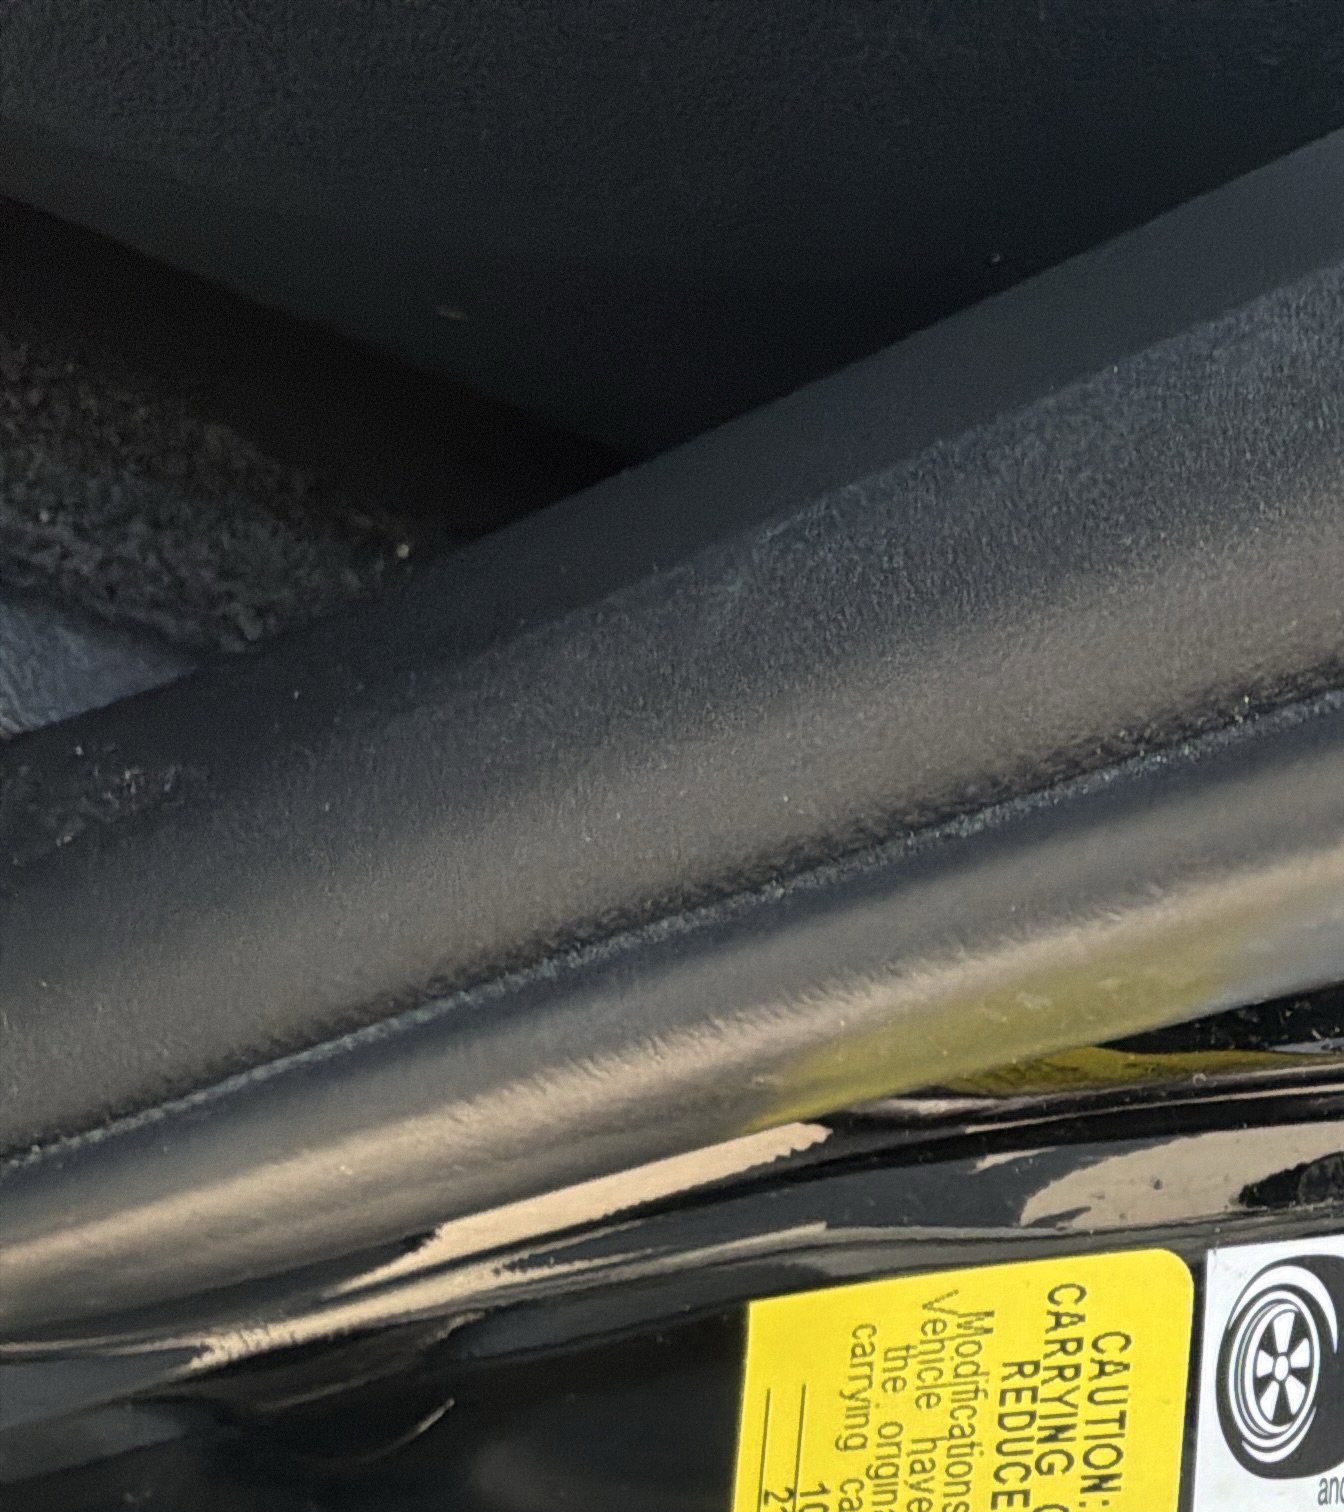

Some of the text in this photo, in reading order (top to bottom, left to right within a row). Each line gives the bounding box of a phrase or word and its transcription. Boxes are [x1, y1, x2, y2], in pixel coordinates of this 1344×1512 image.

[834, 1322, 879, 1452] carrying
[881, 1343, 916, 1393] the
[915, 1288, 960, 1410] Vehicle
[1034, 1283, 1087, 1476] CARRYING
[1078, 1331, 1132, 1507] CAUTION:
